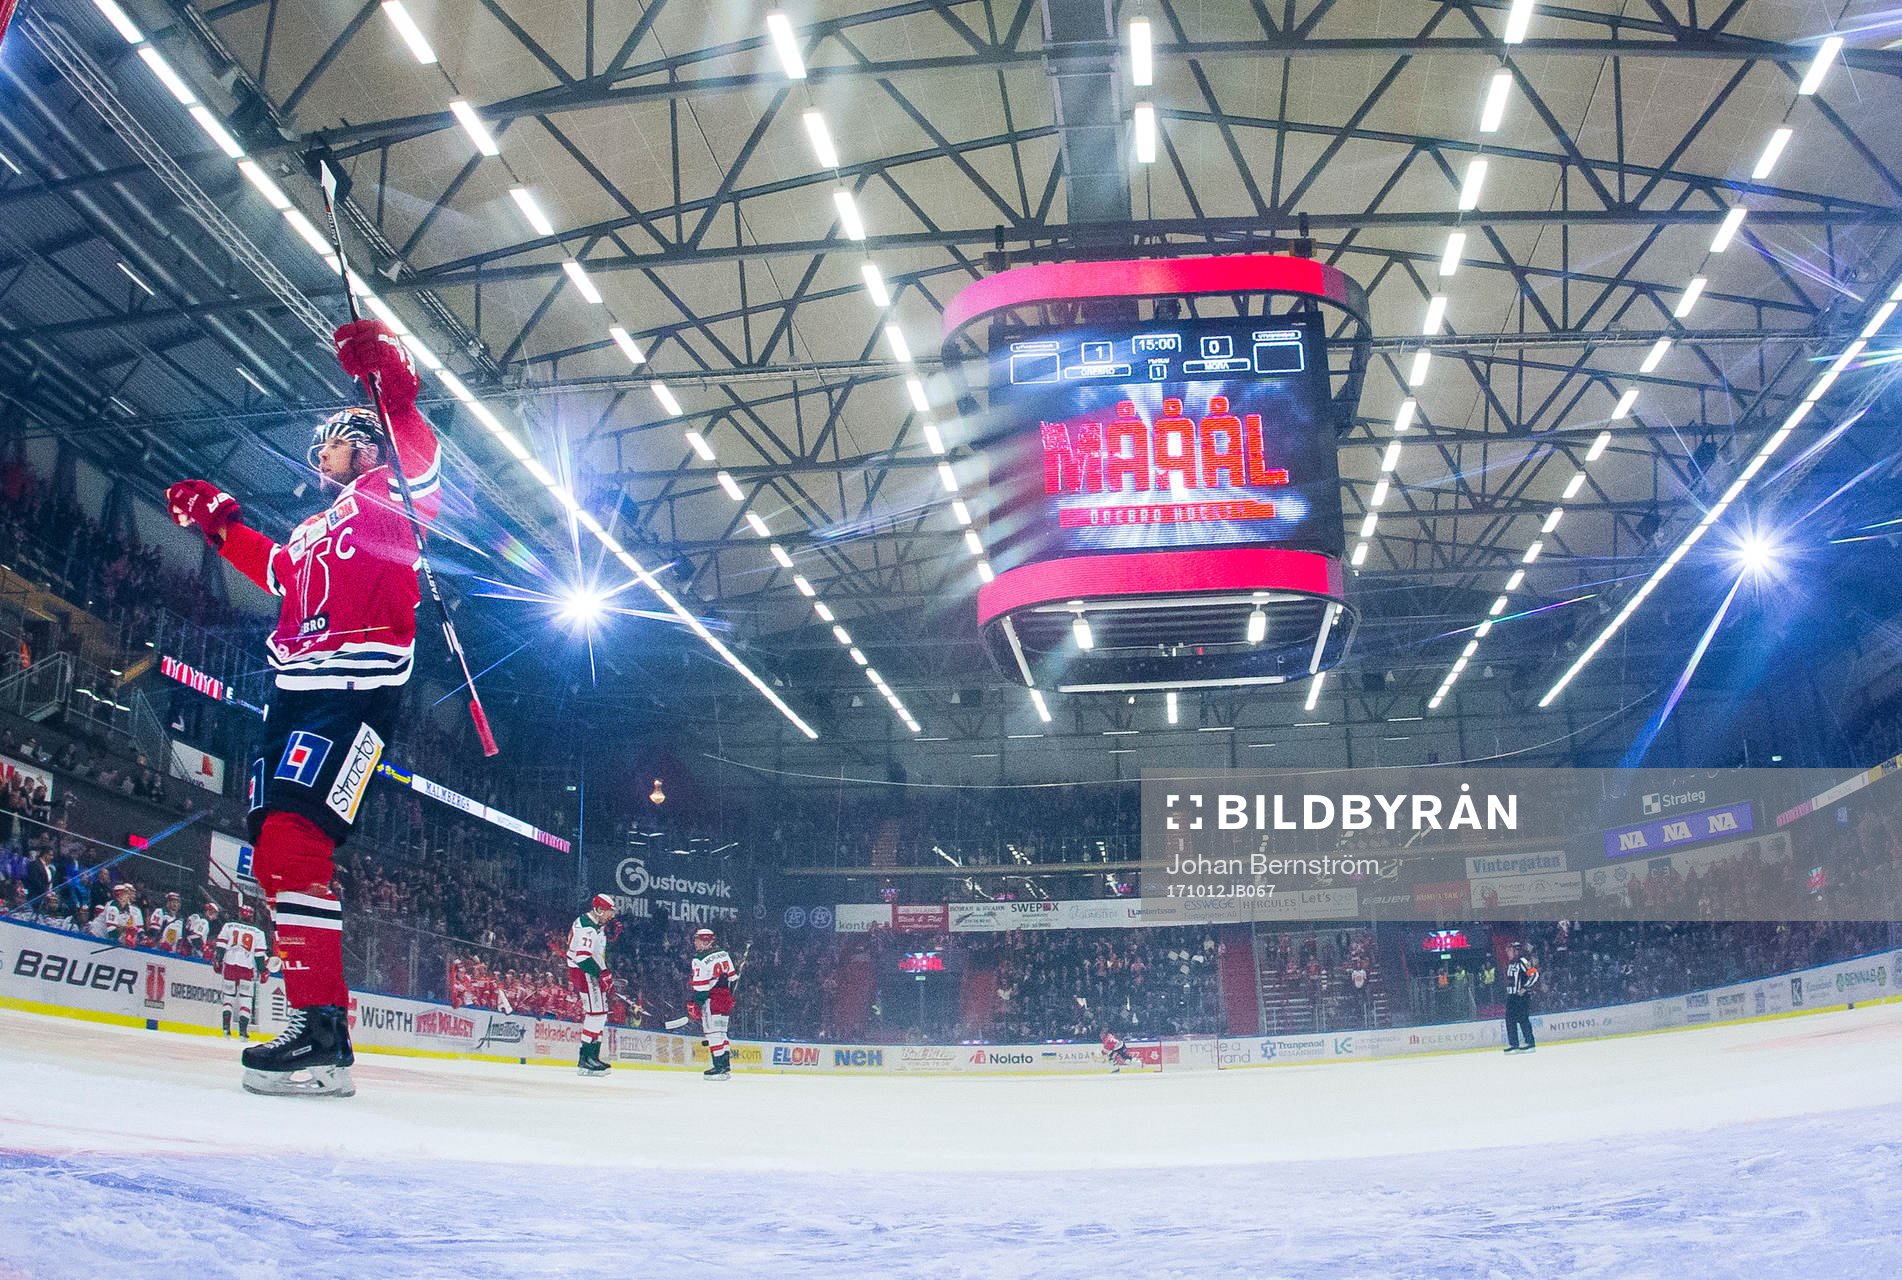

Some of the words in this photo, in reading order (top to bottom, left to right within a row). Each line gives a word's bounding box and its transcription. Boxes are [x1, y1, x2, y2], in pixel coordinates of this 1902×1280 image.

[1138, 338, 1176, 350] 15:00
[1208, 340, 1220, 354] 0
[1154, 366, 1162, 377] 1
[335, 526, 356, 560] C
[331, 730, 375, 813] Structor
[1662, 790, 1706, 808] Strateg
[1618, 830, 1648, 851] NA
[1662, 821, 1692, 843] NA
[1707, 812, 1738, 834] NA
[1473, 855, 1561, 874] Vintergatan
[1183, 898, 1235, 910] ESSWEGE
[1243, 898, 1297, 910] HERCULES
[1301, 891, 1331, 904] Let's
[14, 949, 138, 995] BAUER
[361, 1005, 413, 1033] WÜRTH
[773, 1046, 820, 1066] ELON
[989, 1051, 1033, 1065] Nolato
